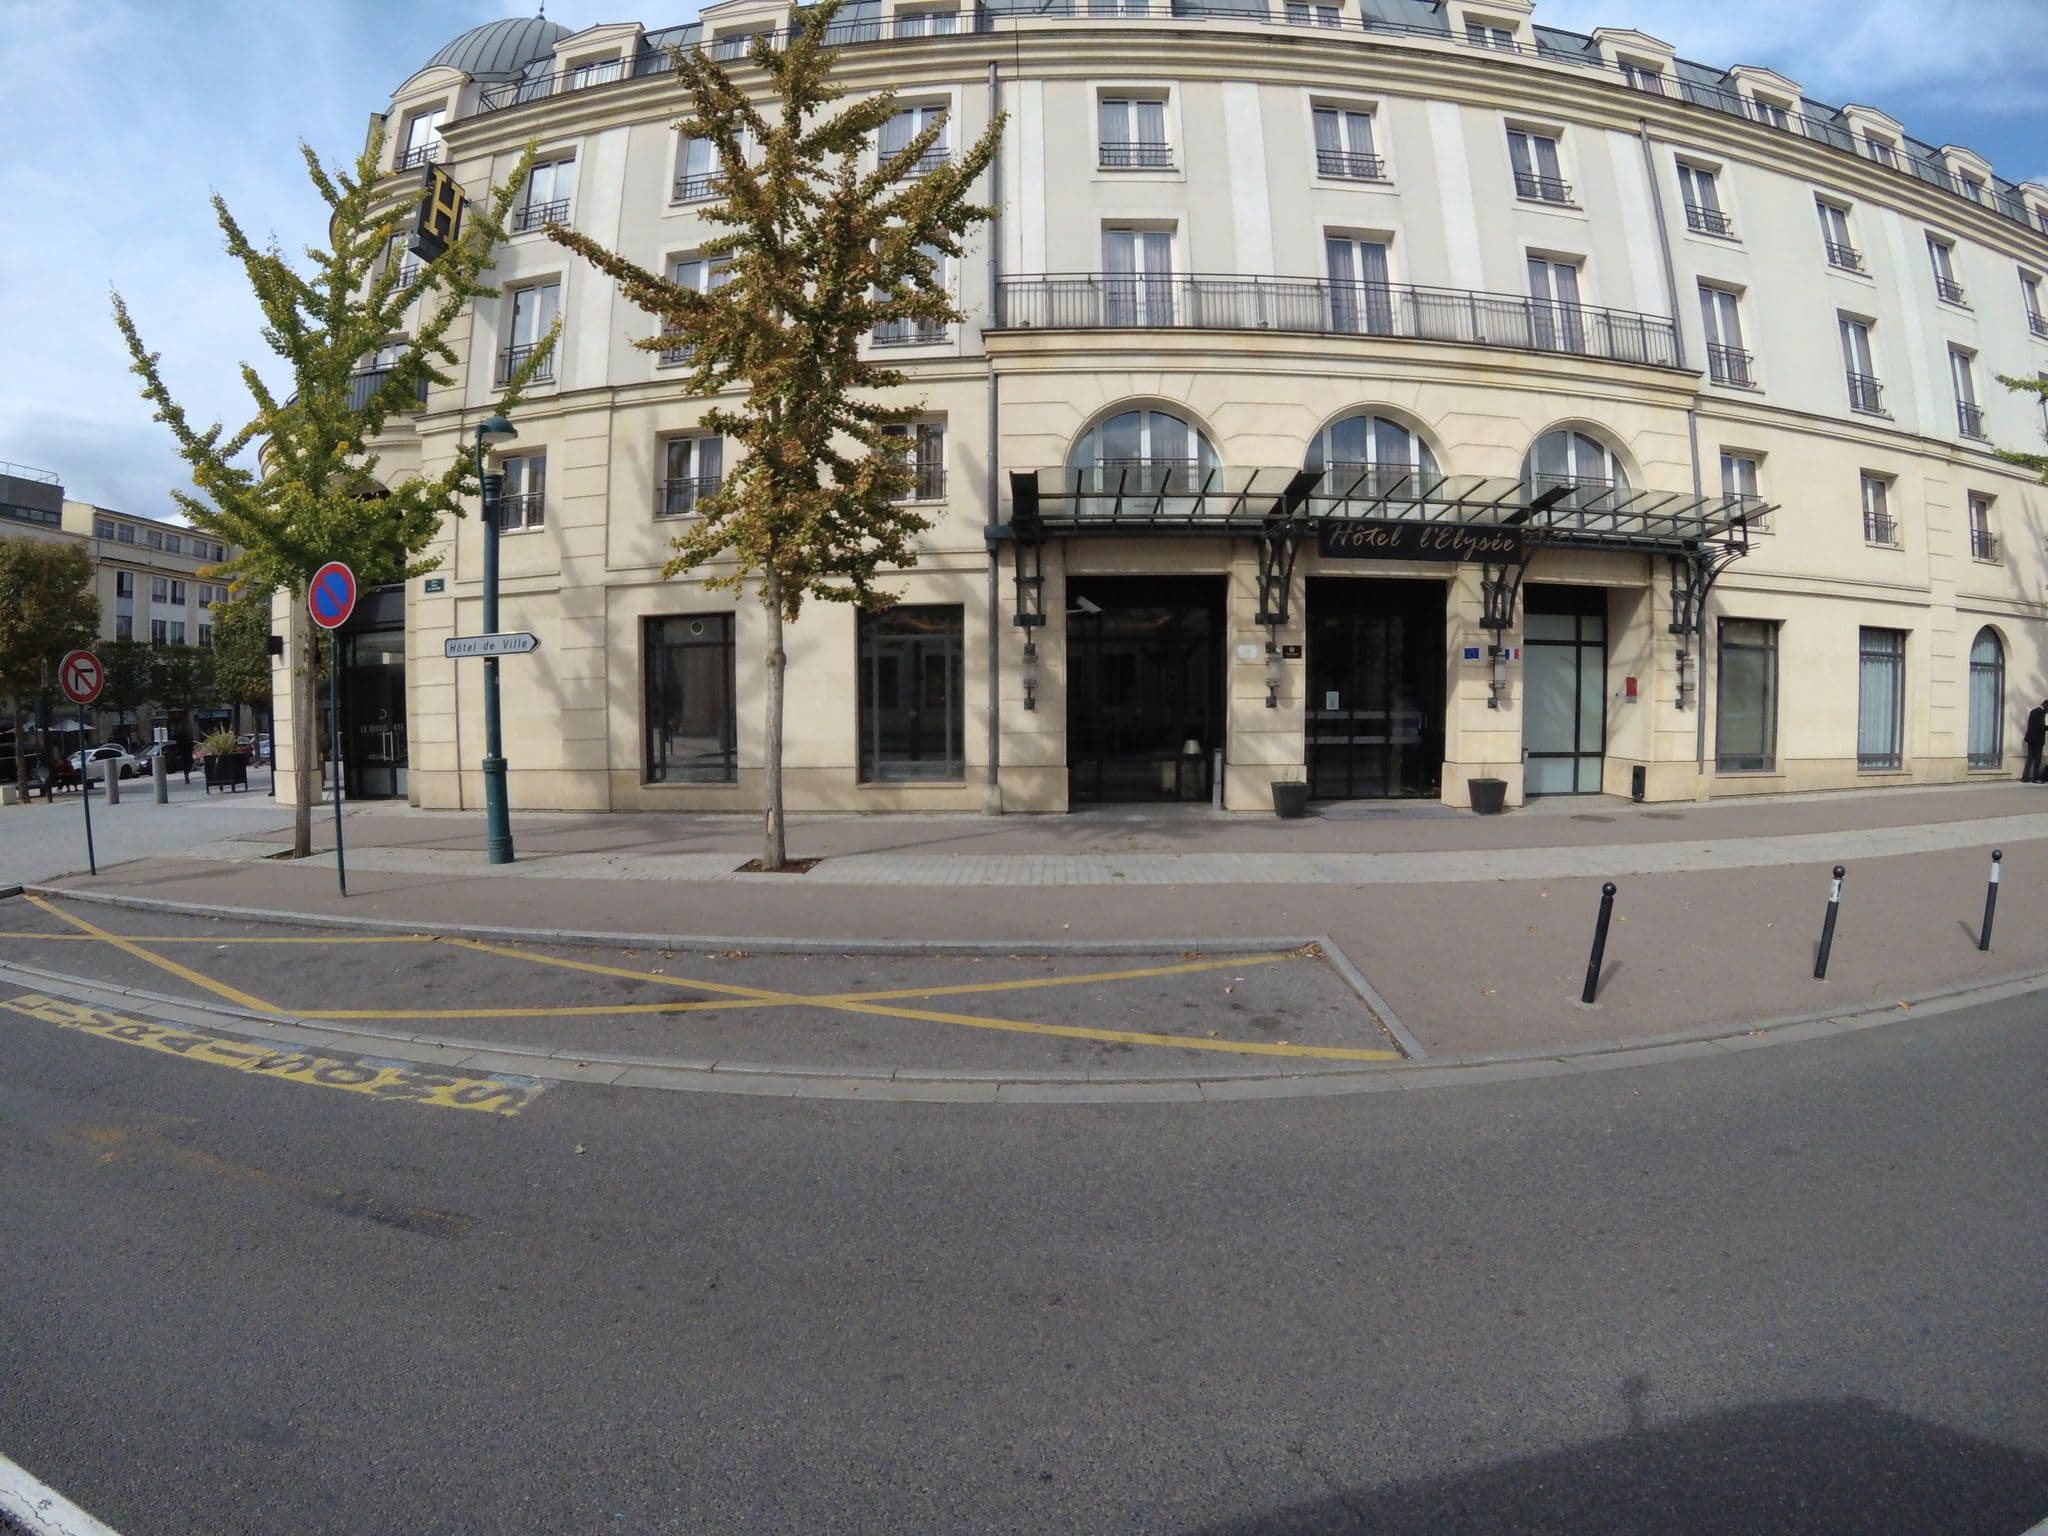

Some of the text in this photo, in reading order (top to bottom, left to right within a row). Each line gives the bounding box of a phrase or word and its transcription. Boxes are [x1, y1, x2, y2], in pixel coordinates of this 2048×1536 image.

[424, 167, 466, 247] H
[1328, 522, 1516, 561] Hôtel l'Elysée
[449, 639, 528, 653] Hôtel de Ville
